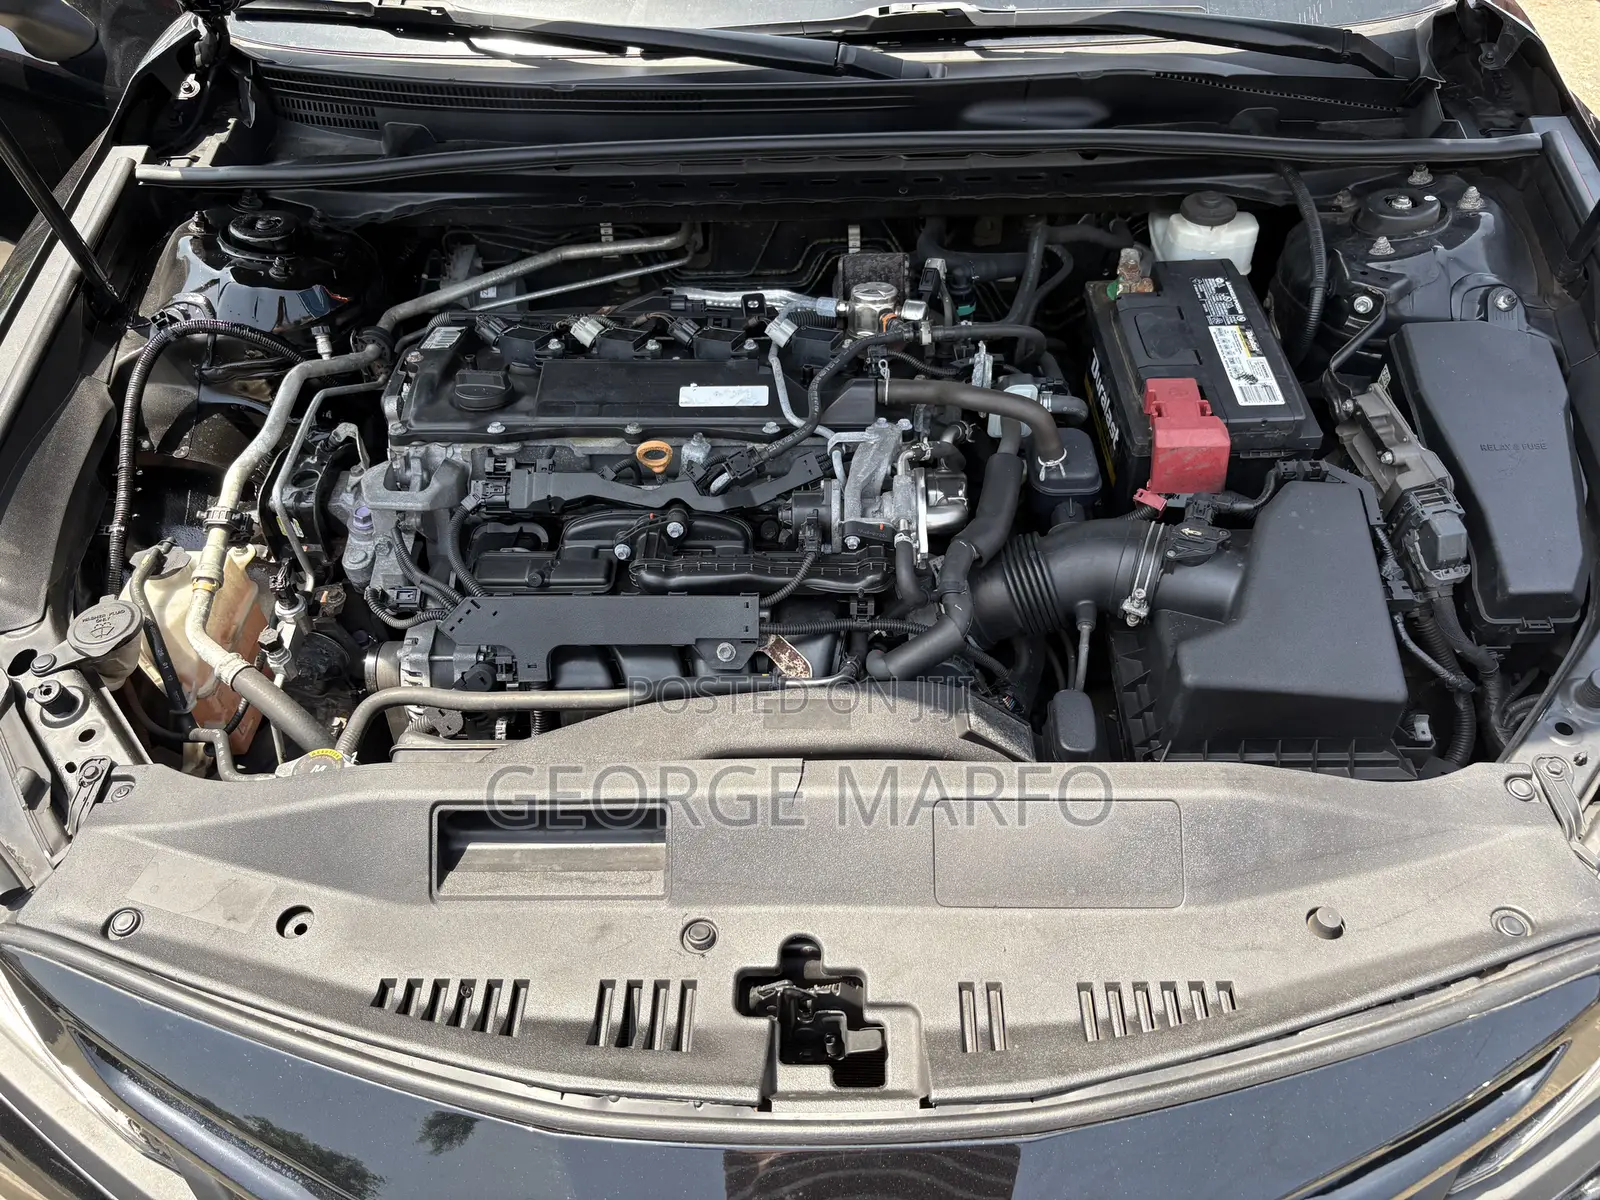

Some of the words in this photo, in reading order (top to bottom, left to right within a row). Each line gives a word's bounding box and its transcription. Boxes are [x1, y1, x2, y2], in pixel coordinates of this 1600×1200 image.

[1091, 347, 1119, 450] Duralast
[1479, 443, 1511, 452] RELAY
[1521, 442, 1548, 451] FUSE
